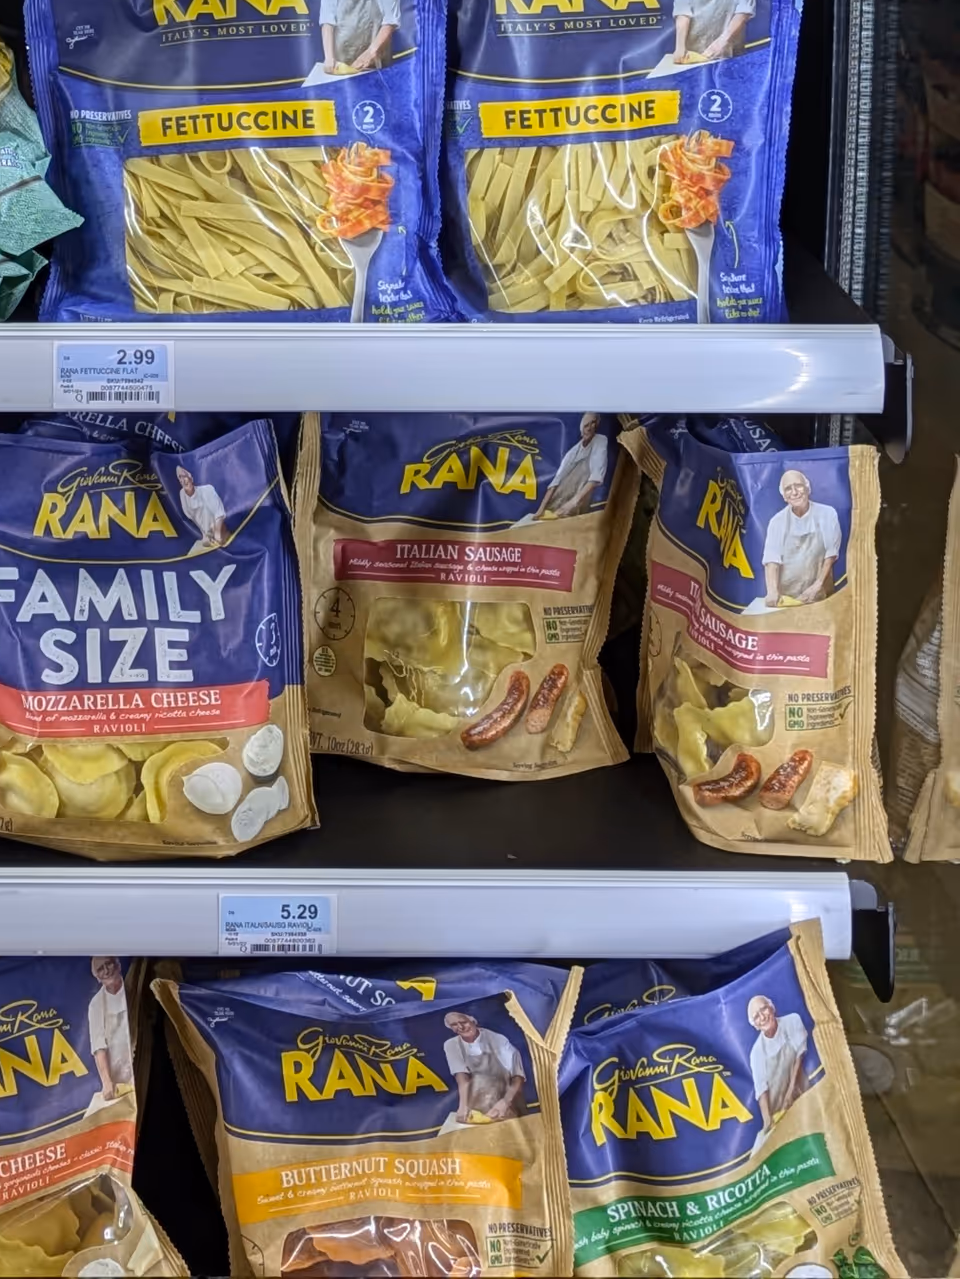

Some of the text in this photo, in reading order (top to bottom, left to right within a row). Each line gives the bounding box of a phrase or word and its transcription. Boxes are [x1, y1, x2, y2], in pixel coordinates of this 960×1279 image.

[162, 23, 307, 42] ITALY'S MOST LOVED
[161, 109, 315, 137] FETTUCCINE
[363, 106, 374, 122] 2
[504, 99, 655, 129] FETTUCCINE
[117, 350, 154, 365] 2.99
[400, 446, 537, 500] RANA
[33, 492, 178, 539] RANA
[396, 545, 522, 562] ITALIAN SAUSAGE
[441, 573, 486, 583] RAVIOLI
[700, 611, 758, 651] SAUSAGE
[40, 627, 193, 685] SIZE
[22, 690, 221, 712] MOZZARELLA CHEESE
[788, 708, 803, 718] NO
[787, 720, 804, 729] GMO
[281, 905, 318, 920] 5.29
[281, 1049, 448, 1103] RANA
[591, 1073, 753, 1146] RANA
[282, 1158, 461, 1188] BUTTERNUT SQUASH
[3, 1177, 50, 1201] RAVIOLI
[350, 1189, 400, 1200] RAVIOLI
[607, 1164, 771, 1224] SPINACH & RICOTTA
